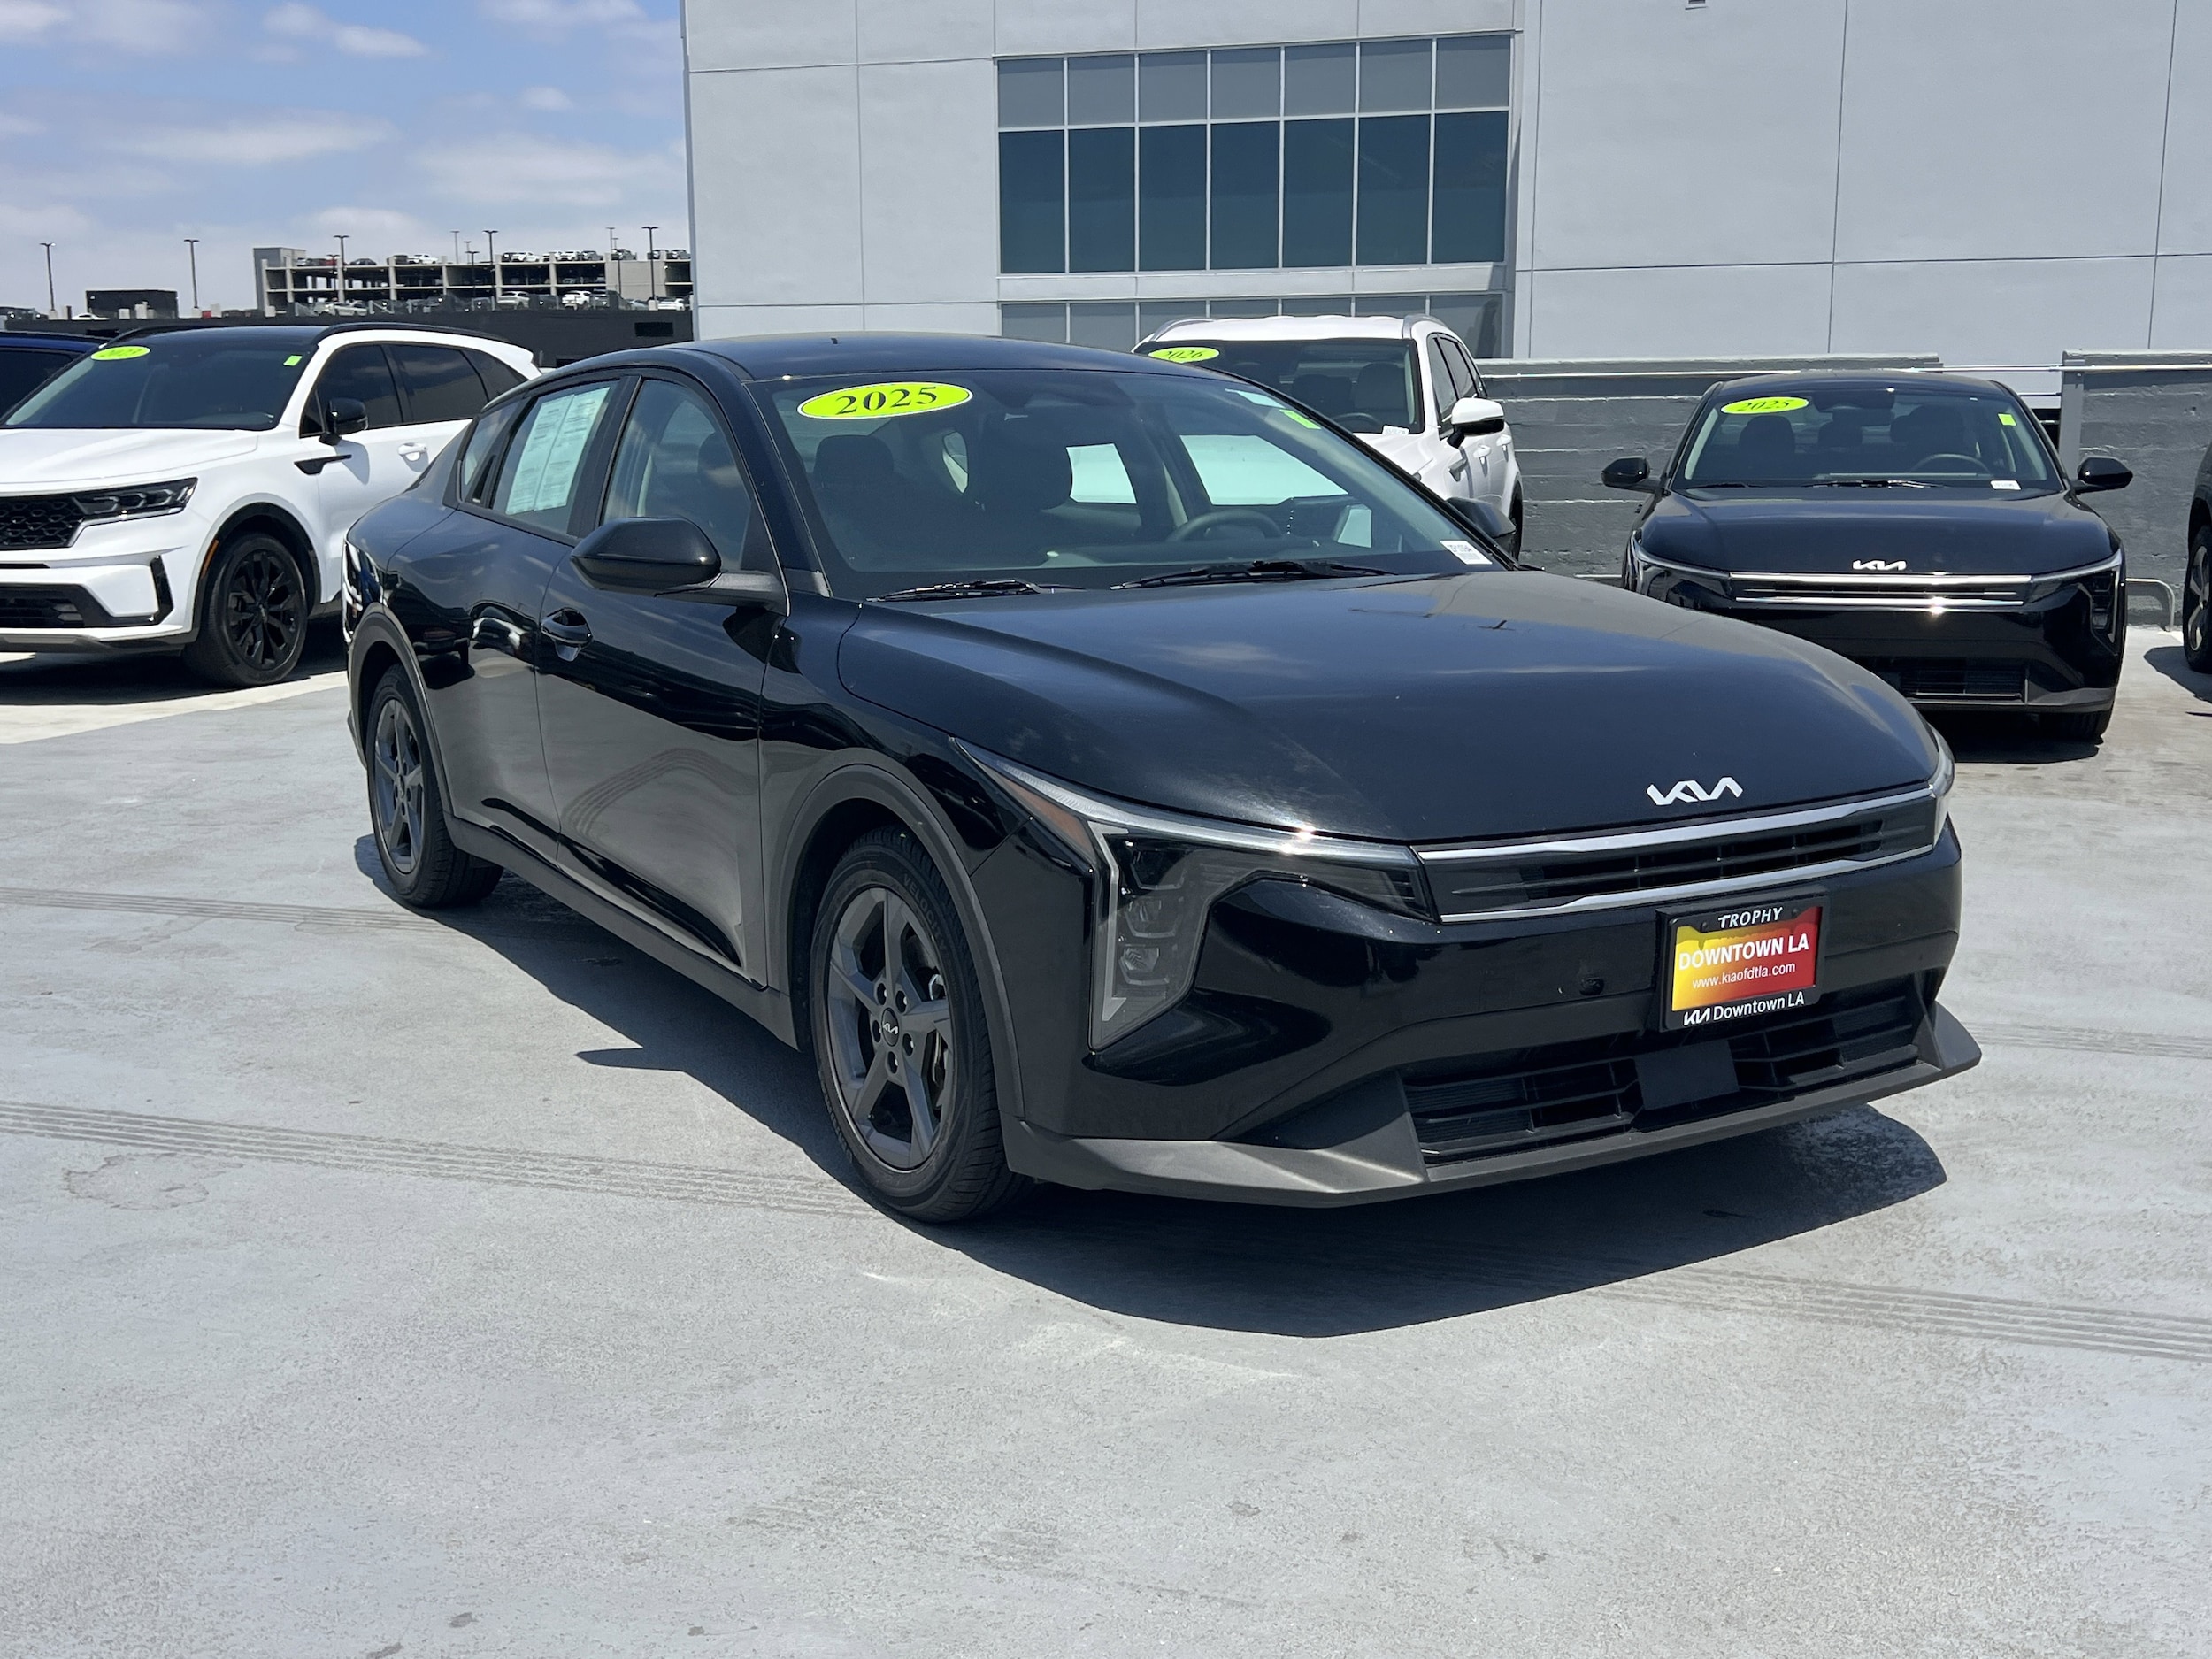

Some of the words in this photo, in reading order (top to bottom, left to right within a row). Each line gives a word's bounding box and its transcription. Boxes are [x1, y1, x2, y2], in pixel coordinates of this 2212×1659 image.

[835, 387, 937, 415] 2025
[1736, 400, 1795, 411] 2025
[1853, 560, 1906, 571] KIA
[1646, 776, 1743, 806] KIA
[1718, 907, 1783, 929] TROPHY
[1678, 937, 1784, 971] DOWNTOWN
[1787, 933, 1809, 953] LA
[1693, 963, 1796, 989] www.kiaofdtla.com
[1683, 1007, 1710, 1026] KIA
[1713, 997, 1786, 1020] Downtown
[1787, 991, 1805, 1008] LA
